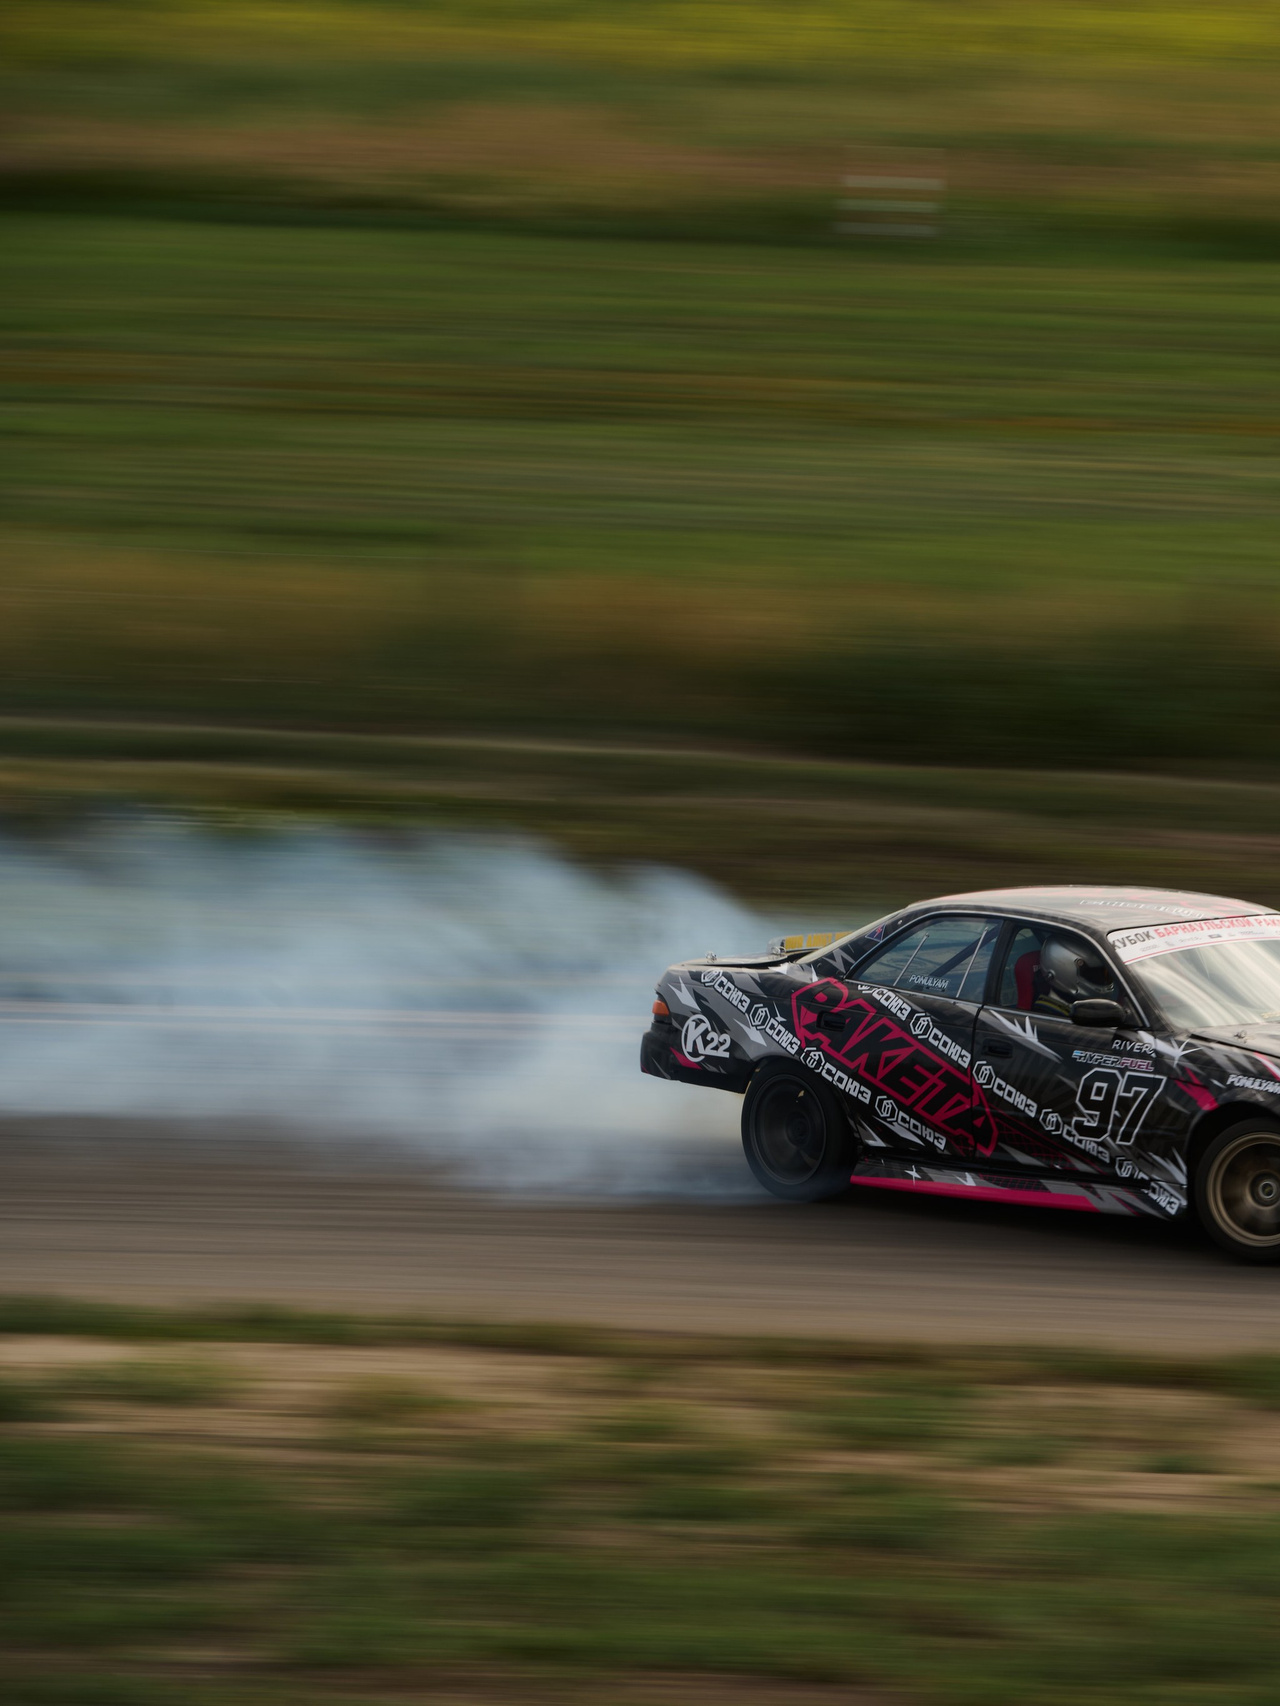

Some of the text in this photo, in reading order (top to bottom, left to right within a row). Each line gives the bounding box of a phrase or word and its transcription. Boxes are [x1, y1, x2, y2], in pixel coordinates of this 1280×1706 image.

[1154, 916, 1254, 938] БАРНАУЛЬСКОЙ
[713, 976, 947, 1151] СОЮЗ СОЮЗ СОЮЗ СОЮЗ
[871, 988, 912, 1021] СОЮЗ
[928, 1029, 972, 1069] СОЮЗ
[992, 1076, 1037, 1118] СОЮЗ
[1062, 1123, 1111, 1164] СОЮЗ
[1071, 1067, 1167, 1145] 97
